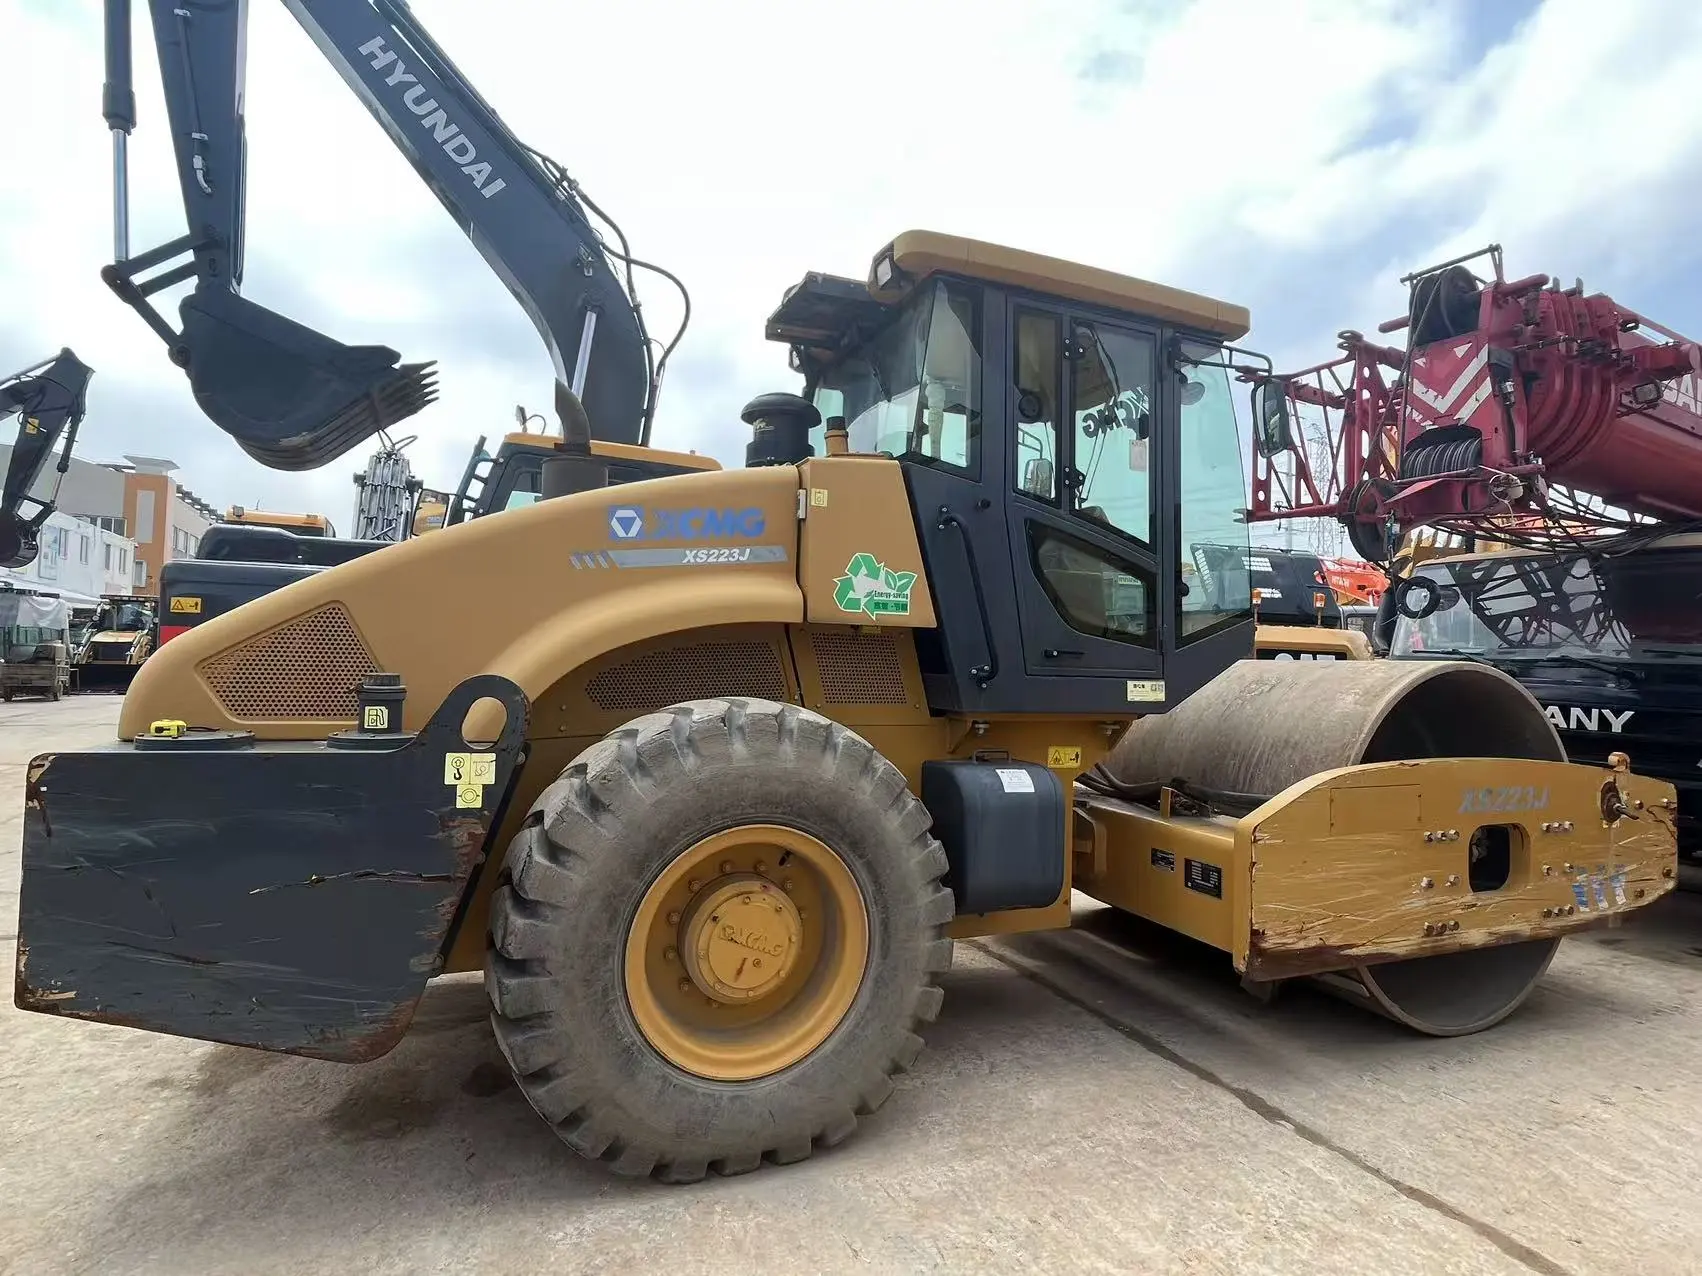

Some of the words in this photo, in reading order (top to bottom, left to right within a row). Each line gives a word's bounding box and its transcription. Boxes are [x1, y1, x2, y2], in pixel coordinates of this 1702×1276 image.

[358, 36, 506, 198] HYUNDAI
[652, 508, 765, 540] XCMG
[682, 548, 750, 564] XS223J
